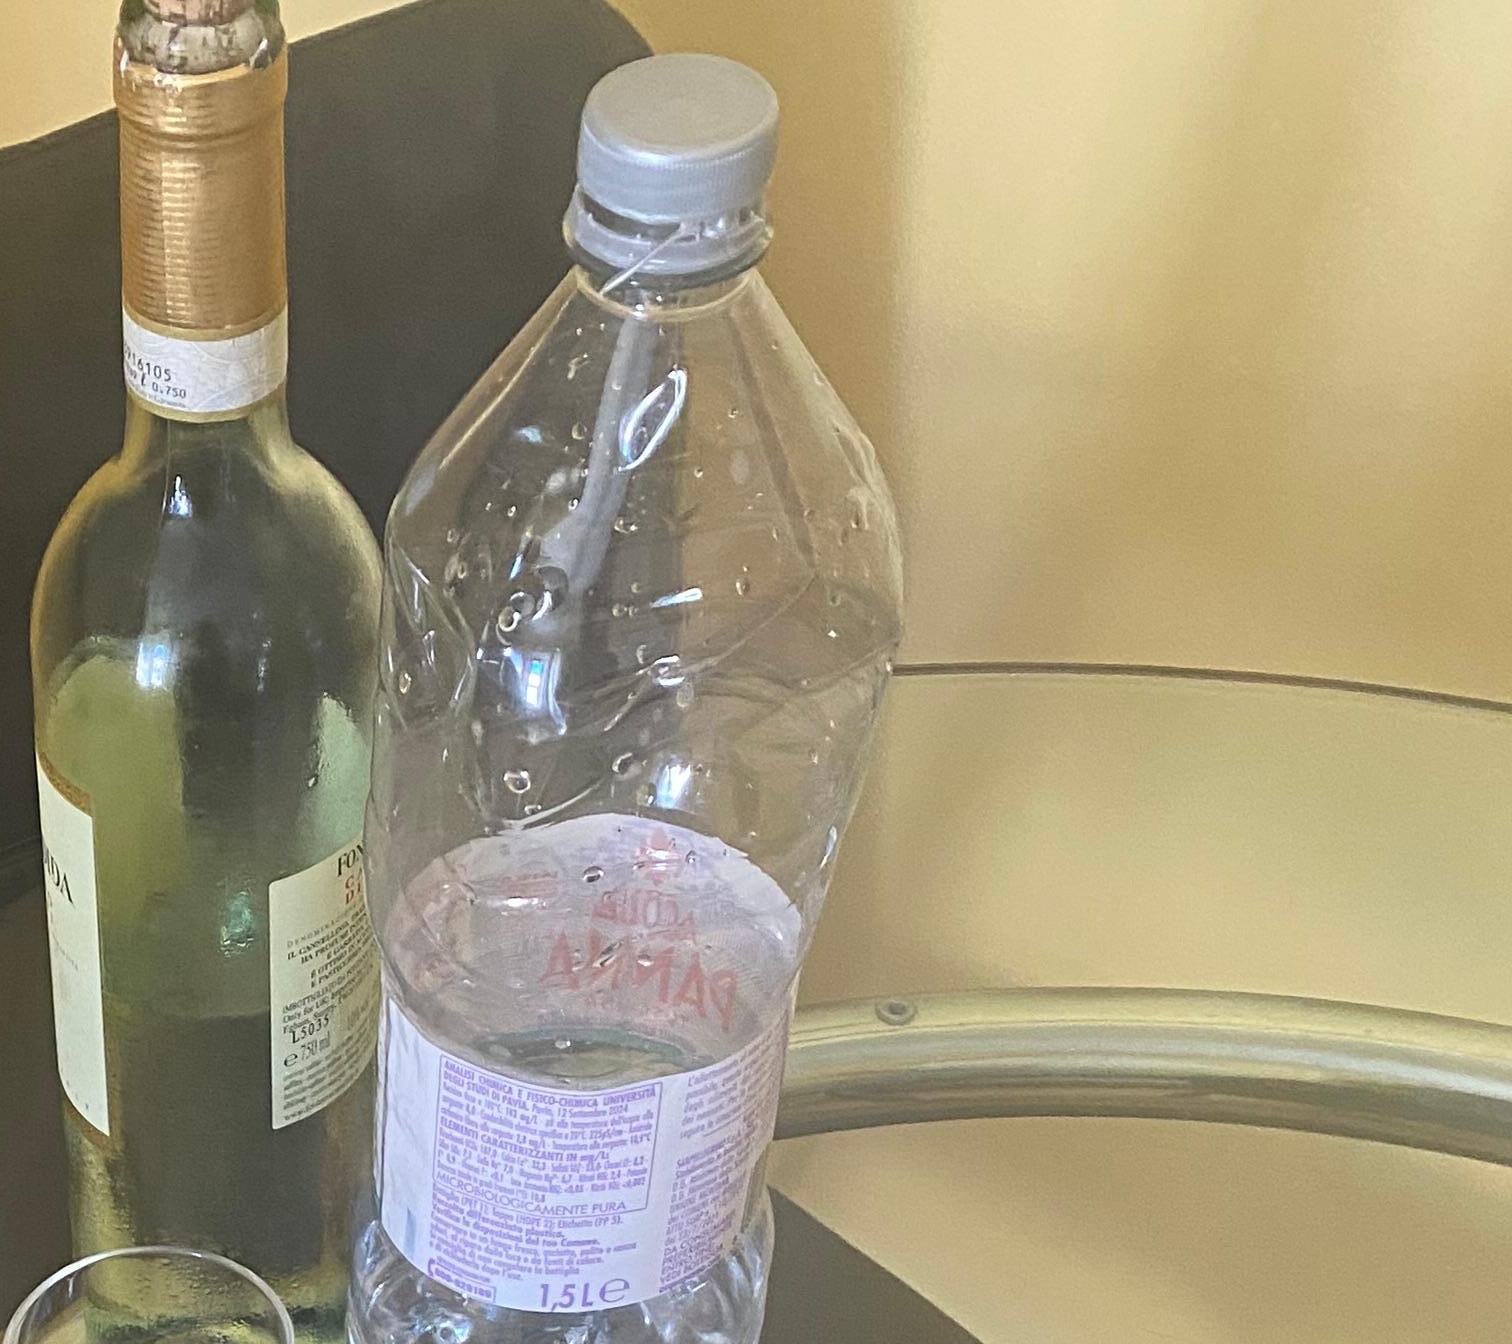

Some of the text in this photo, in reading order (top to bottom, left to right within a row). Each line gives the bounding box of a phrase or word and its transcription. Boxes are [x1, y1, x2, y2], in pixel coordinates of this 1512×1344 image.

[292, 1014, 329, 1043] L5035
[437, 1171, 588, 1215] MICROBIOLOGICAMENTE
[592, 1201, 626, 1214] PURA
